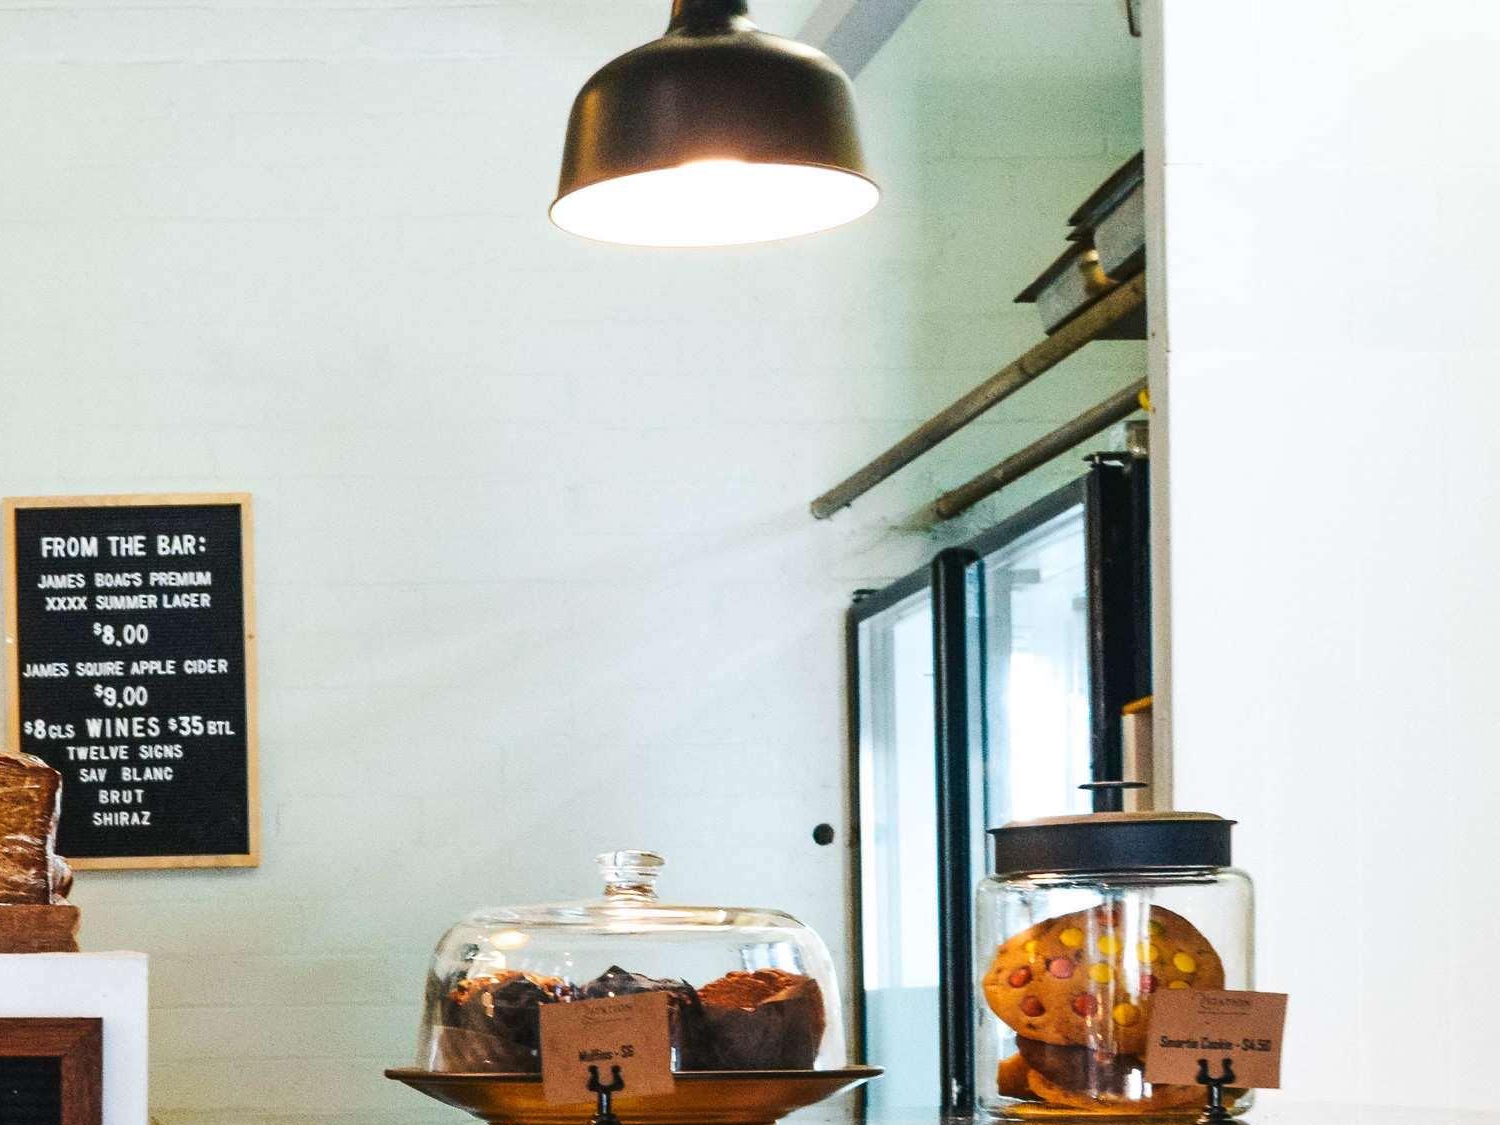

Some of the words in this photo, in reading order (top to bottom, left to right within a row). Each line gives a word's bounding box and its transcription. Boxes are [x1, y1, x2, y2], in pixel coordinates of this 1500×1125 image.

[41, 536, 98, 558] FROM
[107, 535, 146, 557] THE
[157, 534, 206, 555] BAR:
[38, 573, 85, 589] JAMES
[150, 571, 211, 586] PREMIUM
[45, 596, 87, 611] XXXX
[96, 594, 158, 610] SUMMER
[163, 593, 211, 608] LAGER
[93, 622, 148, 647] $8.00
[23, 663, 69, 677] JAMES
[76, 661, 124, 676] SQUIRE
[130, 660, 176, 675] APPLE
[183, 659, 228, 674] CIDER
[94, 684, 148, 708] $9.00
[86, 717, 160, 738] WINES
[66, 745, 129, 760] TWELVE
[139, 744, 183, 759] SIGNS
[80, 768, 107, 782] SAV
[122, 767, 173, 781] BLANC
[99, 789, 144, 804] BRUT
[93, 811, 150, 826] SHIRAZ
